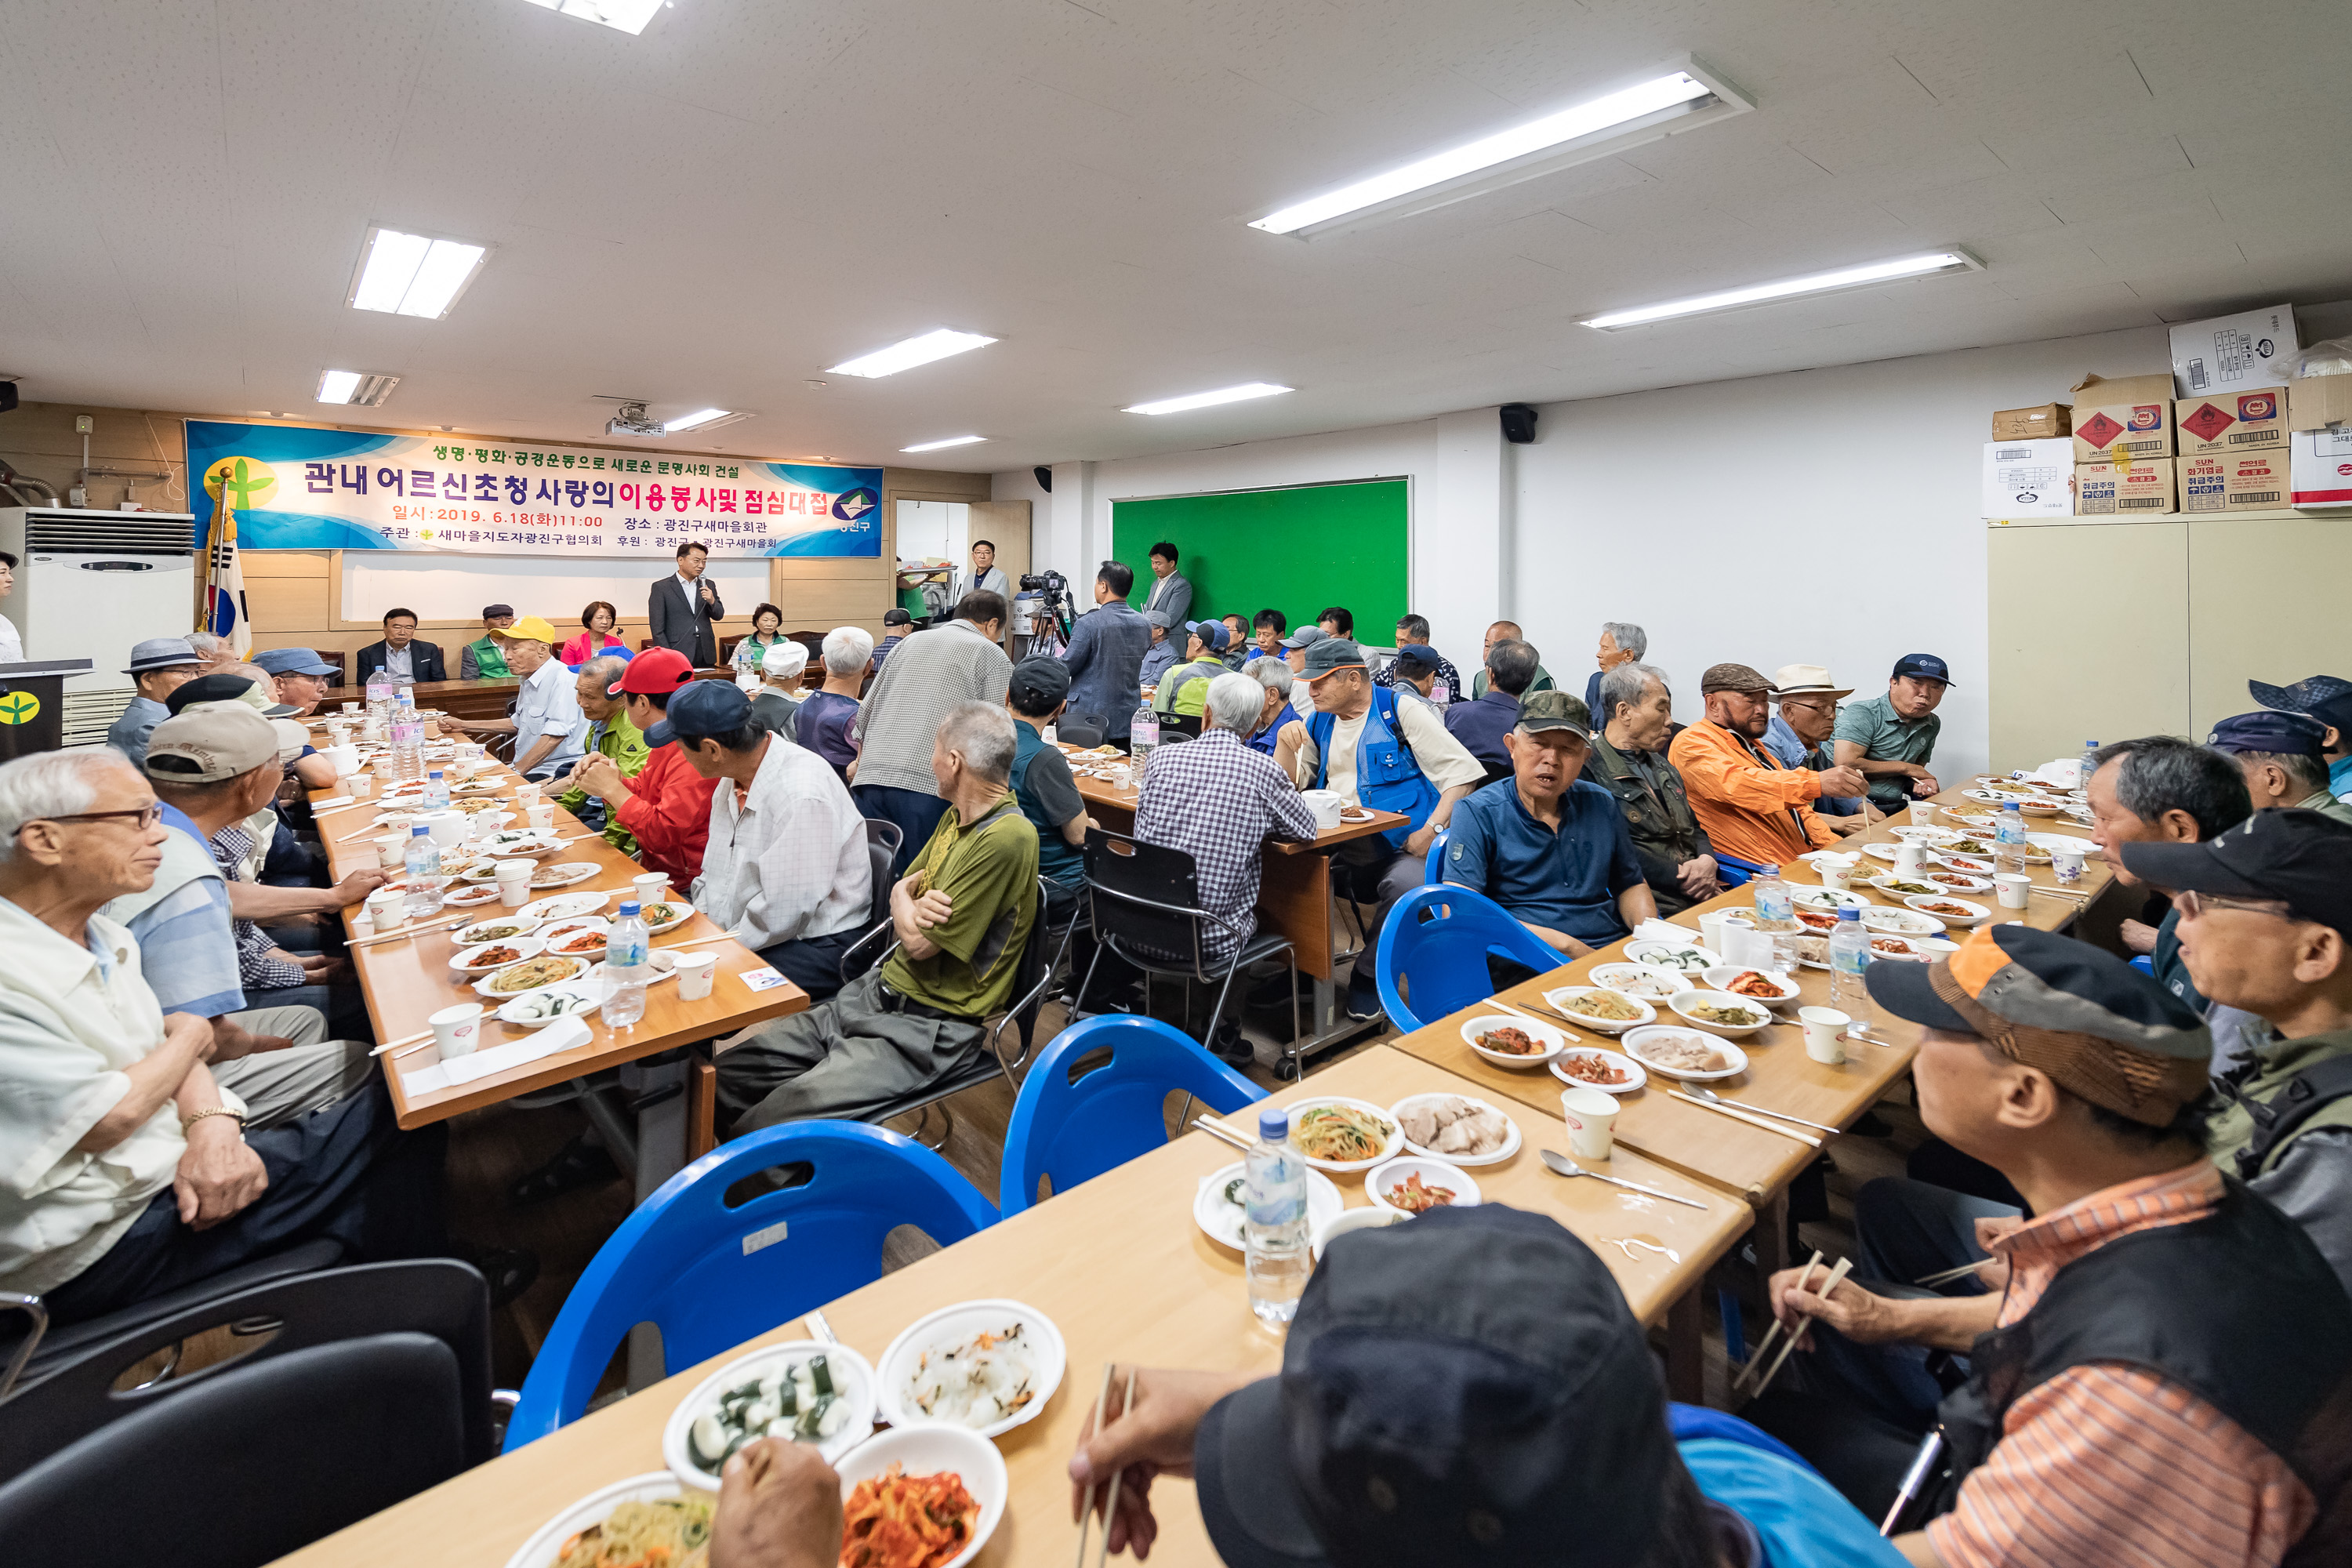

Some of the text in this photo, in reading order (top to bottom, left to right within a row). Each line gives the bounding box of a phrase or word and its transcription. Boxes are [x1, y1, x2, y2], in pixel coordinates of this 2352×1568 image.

[612, 459, 652, 473] 새로운
[658, 461, 710, 477] 문명사회
[715, 465, 739, 478] 건설
[2187, 466, 2223, 475] 화기엄금
[305, 463, 367, 495] 관내
[536, 478, 613, 508] 사랑의
[745, 490, 828, 514] 점심대접
[2188, 476, 2224, 485] 취급주의
[624, 517, 652, 530] 장소
[664, 519, 768, 533] 광진구새마을회관
[379, 527, 410, 539] 주관
[438, 529, 602, 546] 새마을지도자광진구협의회
[617, 536, 641, 546] 후원
[702, 539, 777, 548] 광진구새마을회
